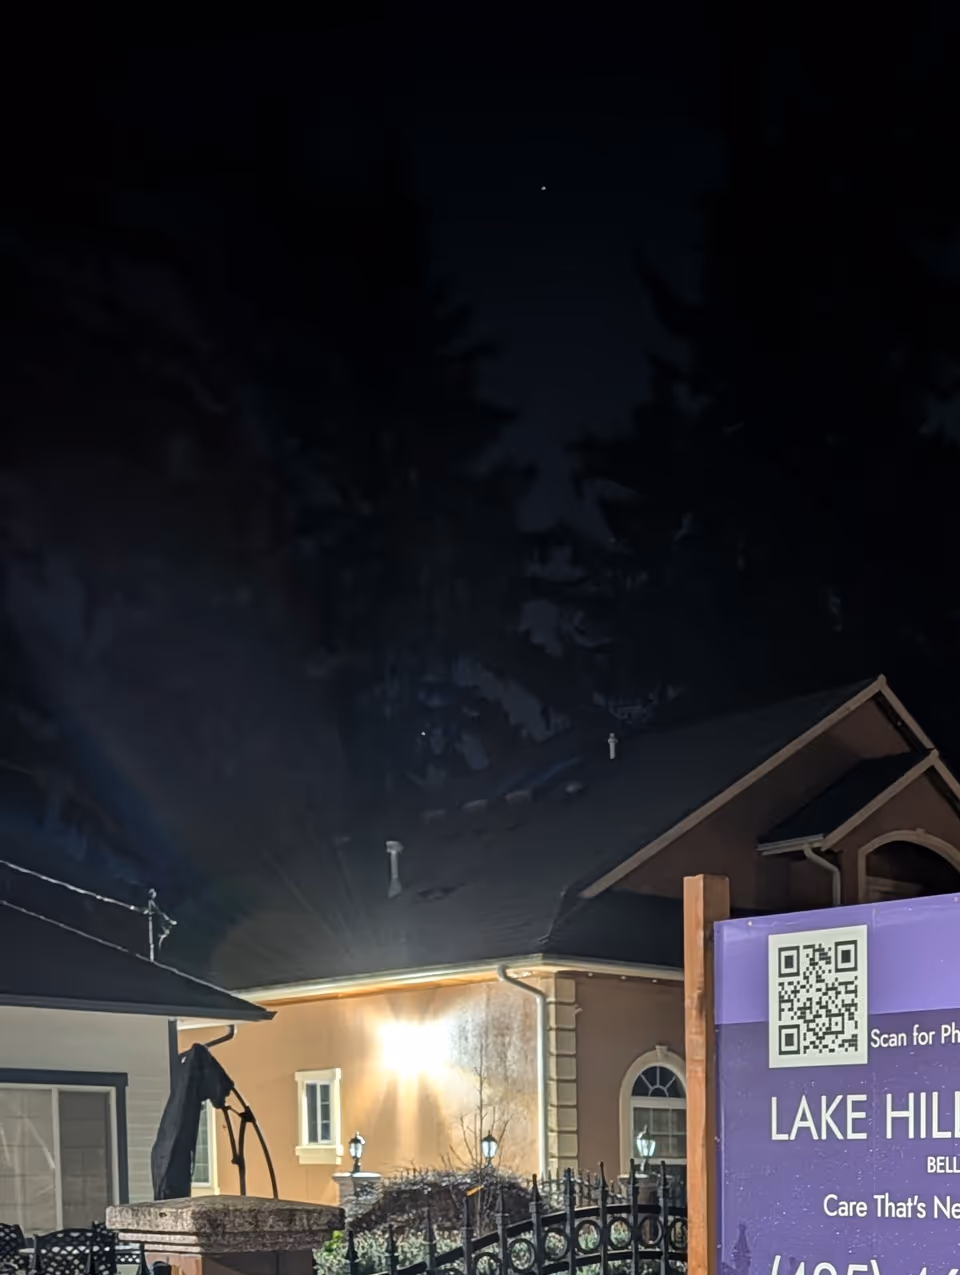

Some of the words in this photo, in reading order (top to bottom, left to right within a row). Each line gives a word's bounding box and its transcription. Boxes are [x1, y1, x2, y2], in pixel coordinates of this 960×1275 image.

[870, 1028, 907, 1048] Scan
[912, 1024, 936, 1046] for
[771, 1094, 868, 1141] LAKE
[823, 1193, 868, 1217] Care
[873, 1192, 927, 1219] That's
